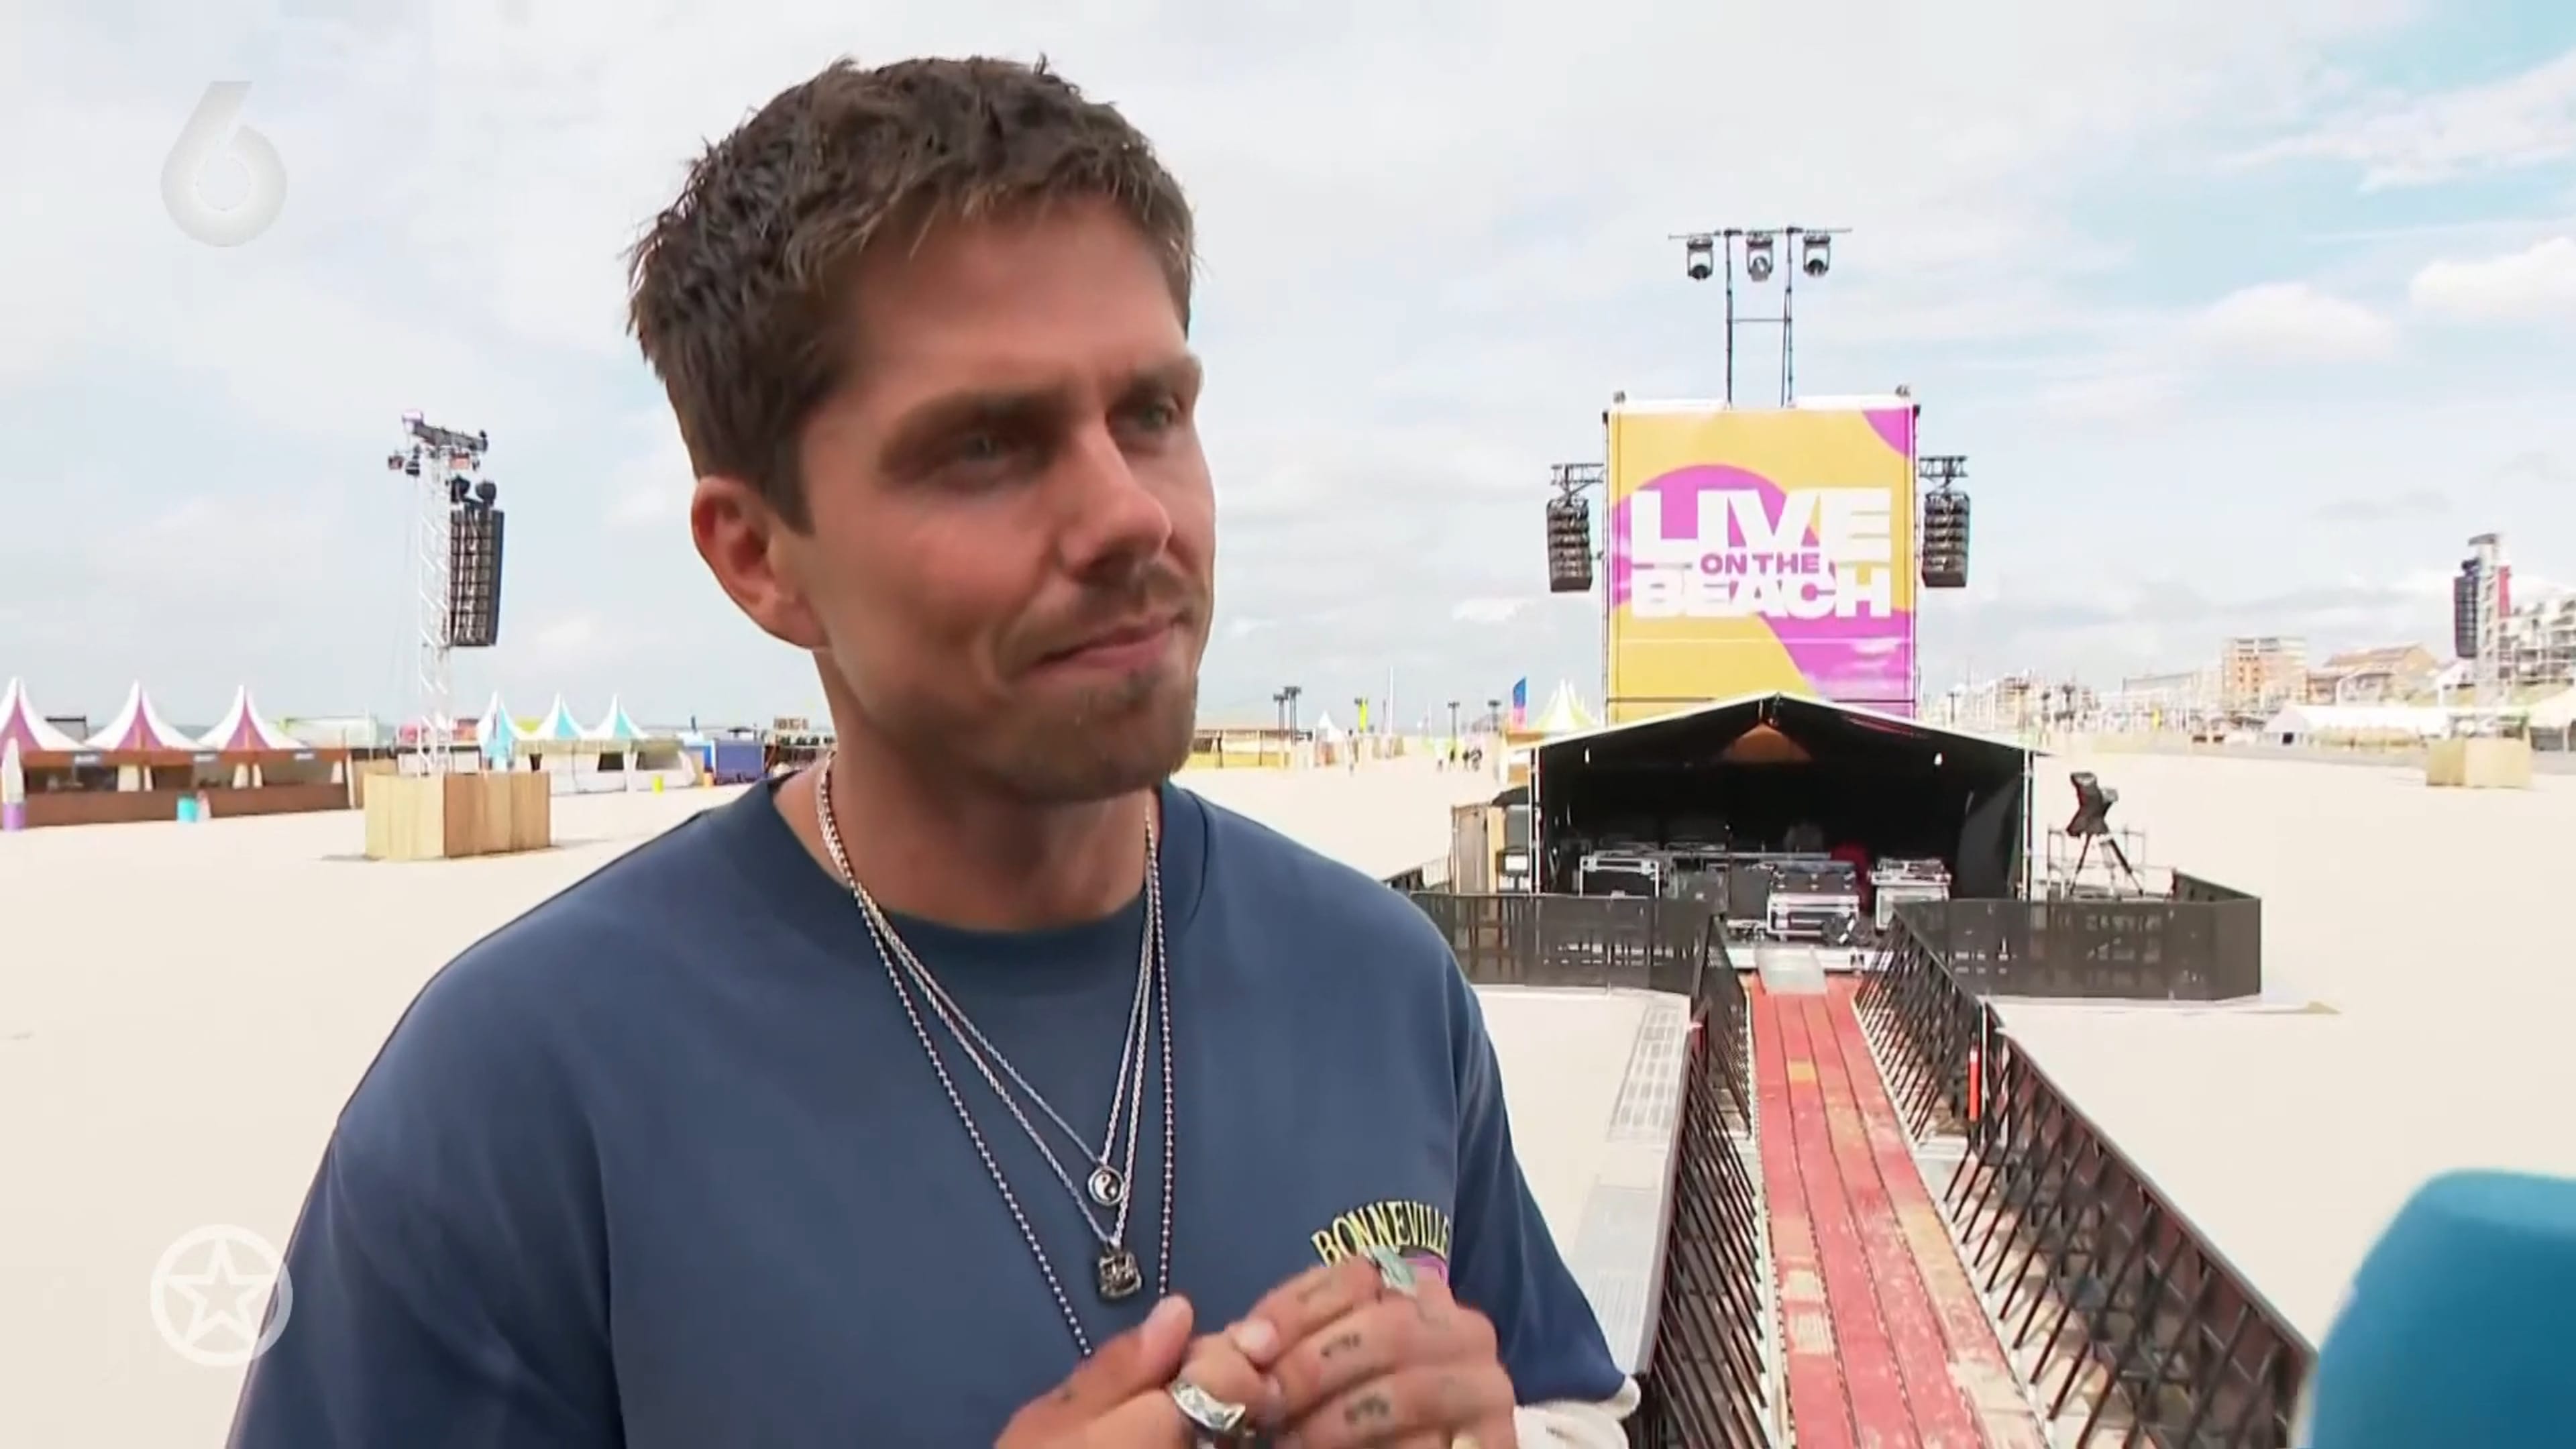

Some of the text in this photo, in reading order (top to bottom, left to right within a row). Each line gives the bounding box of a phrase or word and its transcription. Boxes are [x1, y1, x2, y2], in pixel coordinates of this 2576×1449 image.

[1631, 488, 1890, 564] LIVE
[1701, 553, 1820, 576] ON THE
[1632, 567, 1890, 619] BEACH
